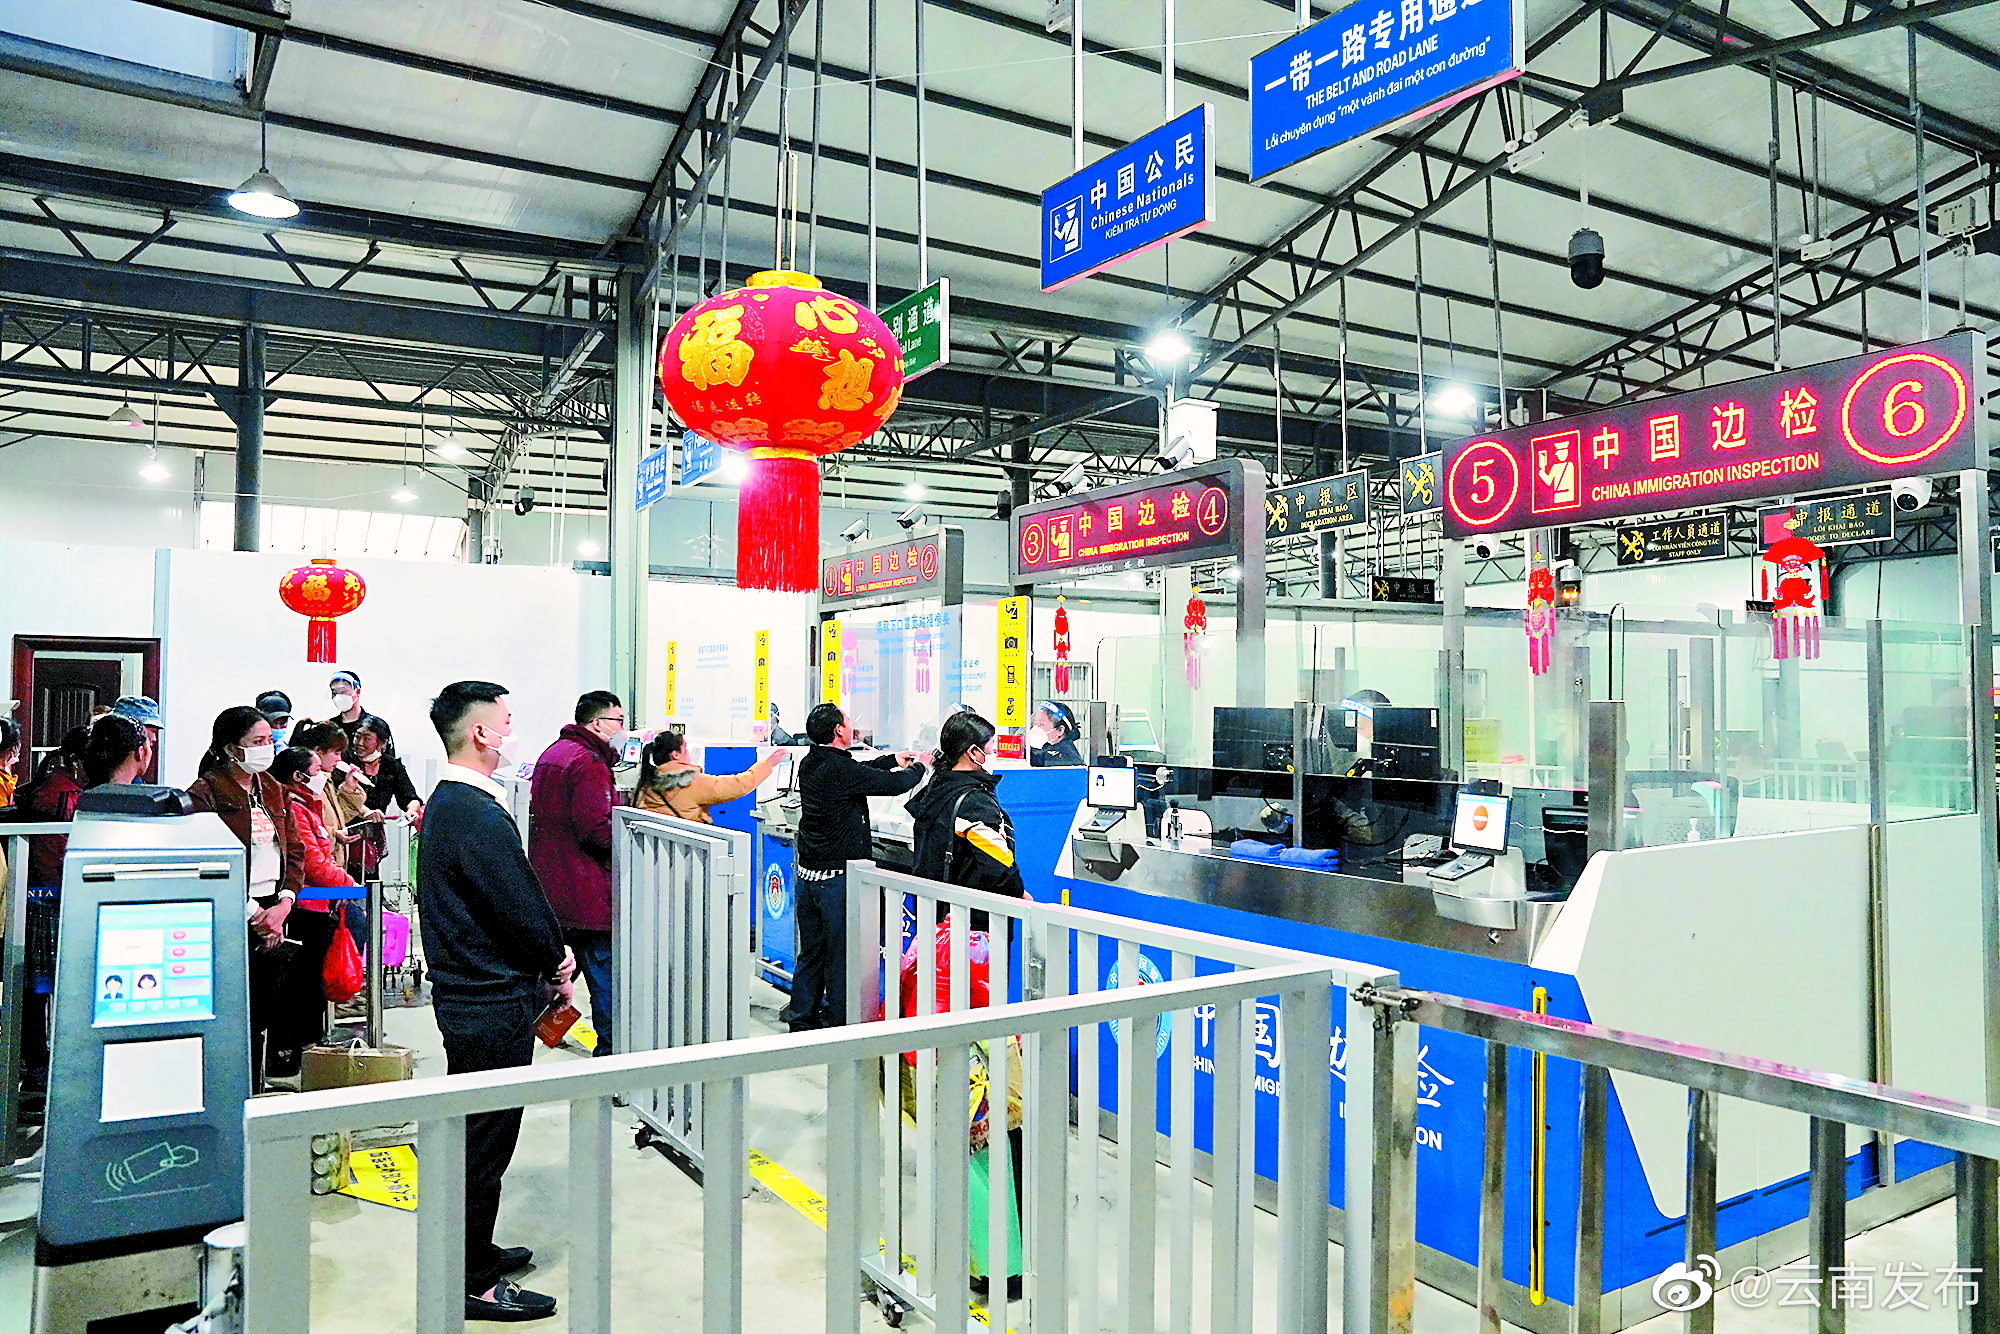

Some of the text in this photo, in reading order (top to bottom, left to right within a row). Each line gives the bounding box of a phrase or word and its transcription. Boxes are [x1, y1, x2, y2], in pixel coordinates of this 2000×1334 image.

[1265, 0, 1481, 91] 一带一路专用通
[1306, 34, 1438, 109] THE BELT AND ROAD LANE
[1426, 61, 1445, 77] con
[1090, 133, 1195, 210] 中国公民
[1091, 172, 1194, 230] Chinese Nationals
[1124, 215, 1139, 233] TRA
[885, 296, 935, 339] 别通道
[679, 304, 754, 390] 福
[1592, 386, 1818, 470] 中国边检
[1295, 481, 1359, 512] 申报区
[1592, 451, 1820, 502] CHINA IMMIGRATION INSPECTION
[1078, 490, 1191, 538] 中国边检
[1796, 500, 1883, 526] 申报通道
[1841, 528, 1876, 538] DECLARE
[856, 546, 918, 578] 中国边检
[1078, 530, 1190, 557] CHINA IMMIGRATION INSPECTION
[1686, 548, 1702, 556] ONLY
